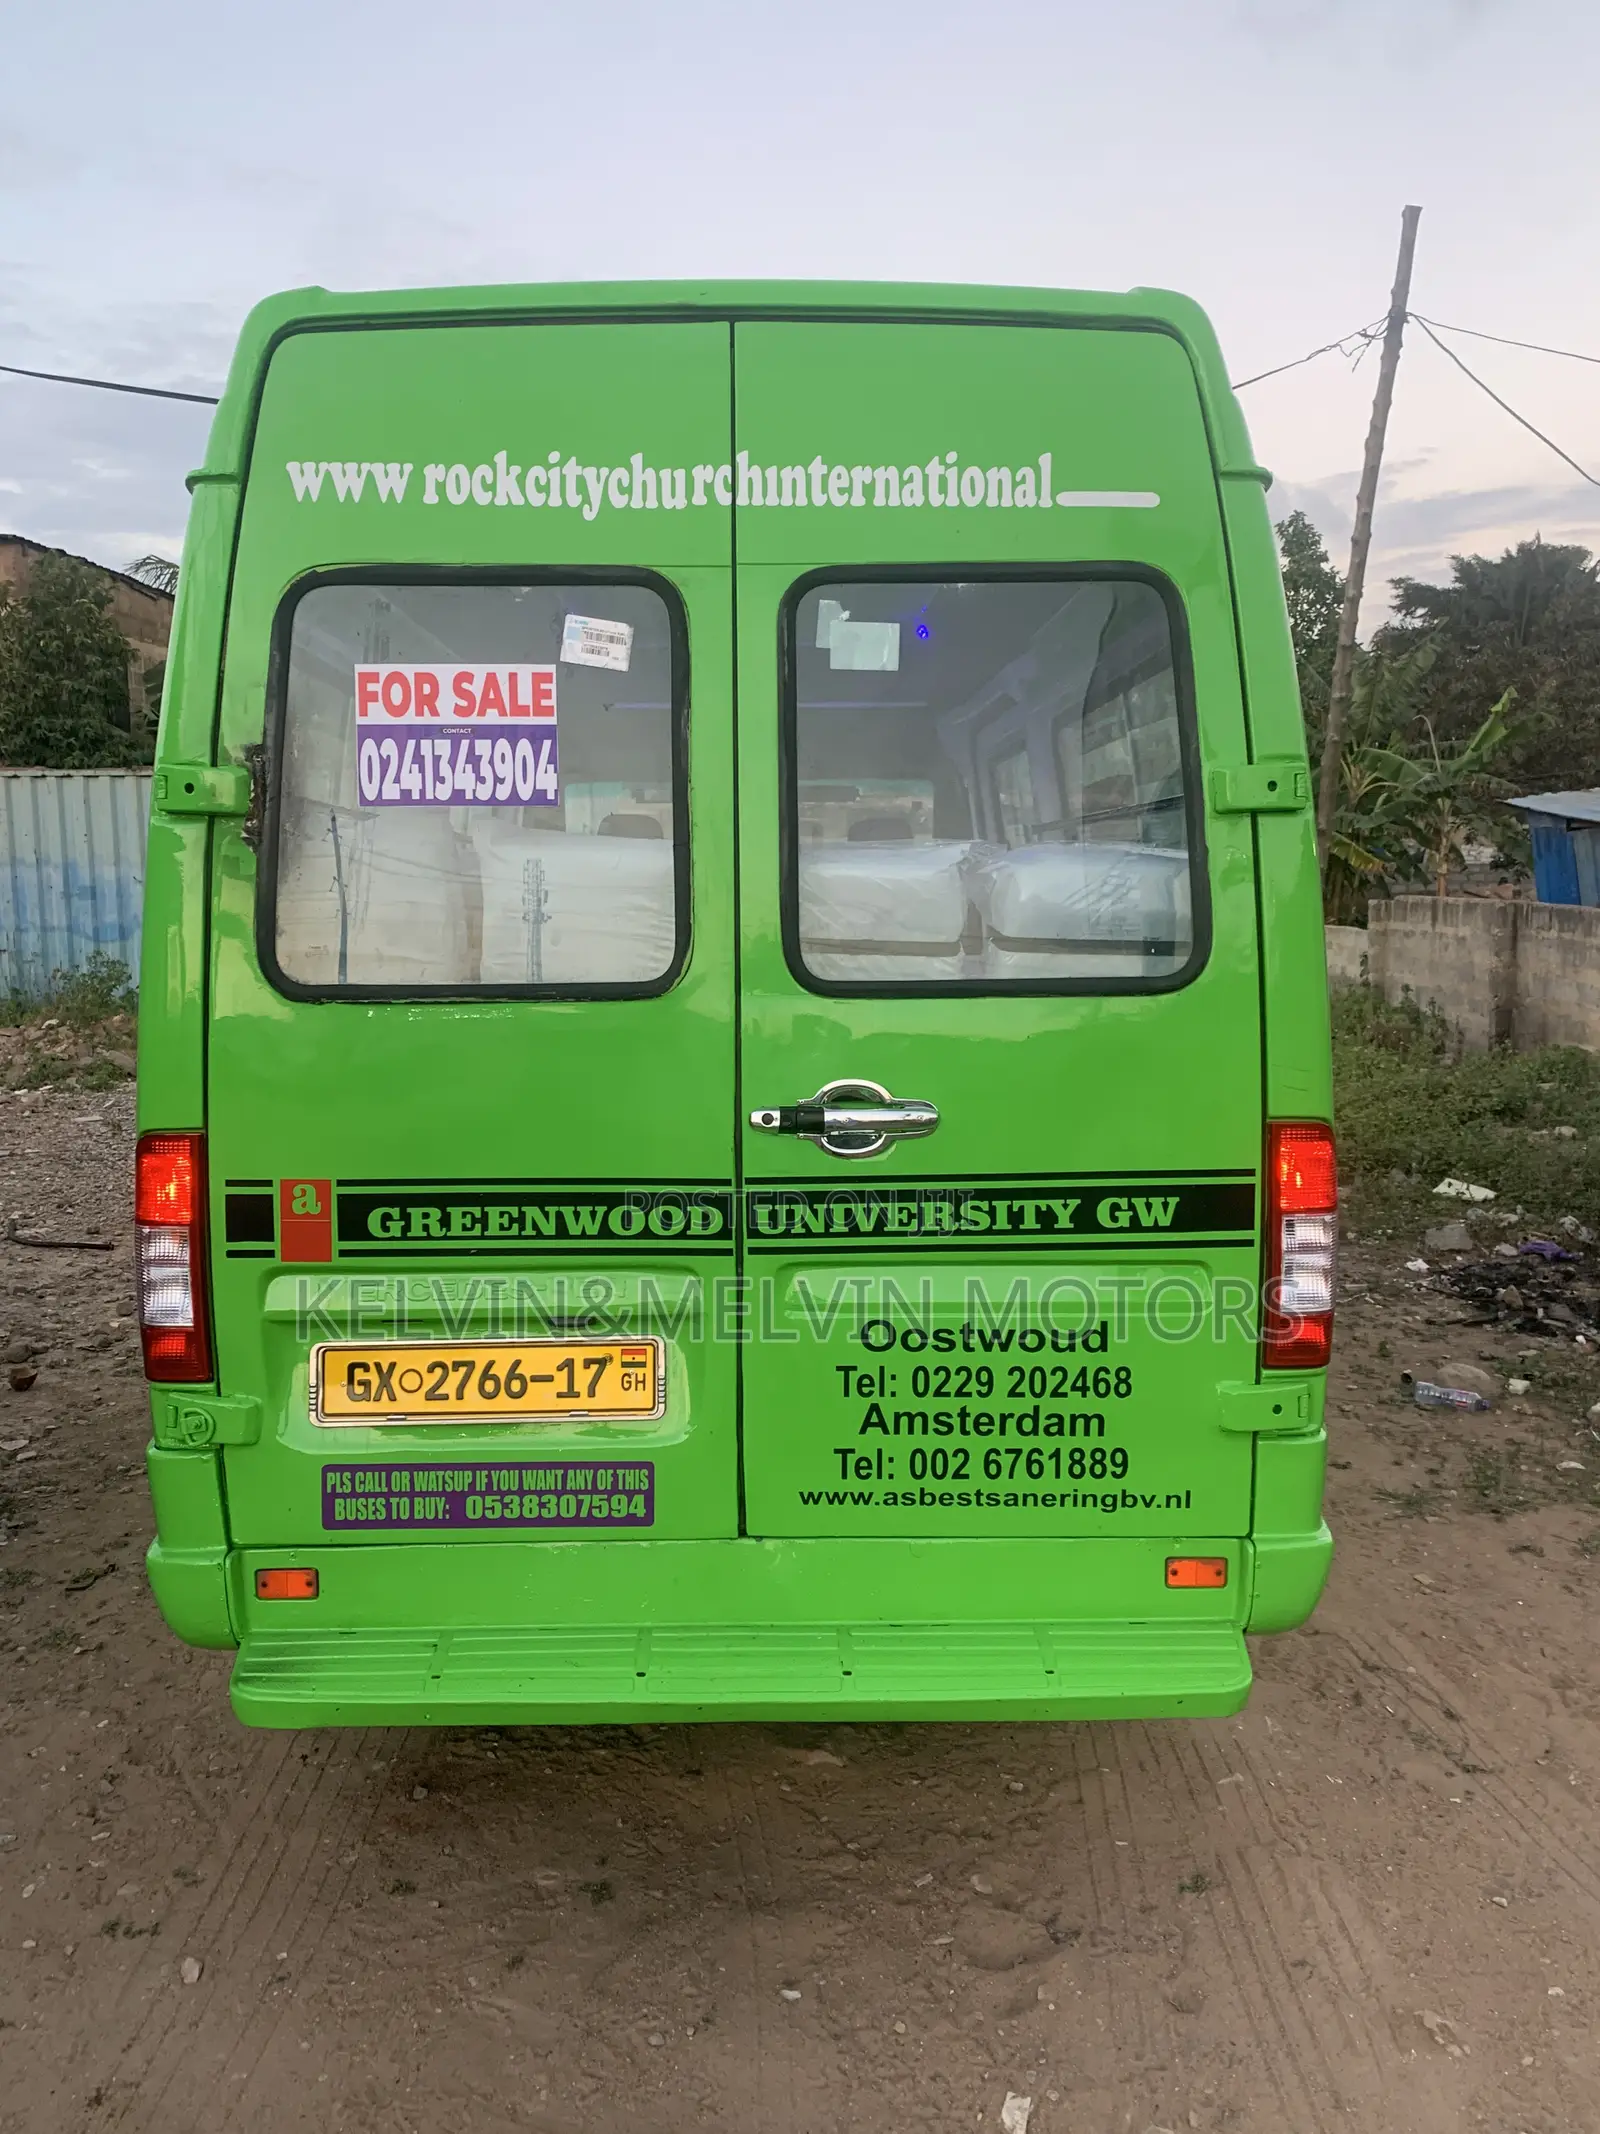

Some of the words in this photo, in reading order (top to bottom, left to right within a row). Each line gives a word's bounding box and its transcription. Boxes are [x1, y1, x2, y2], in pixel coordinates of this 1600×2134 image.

[285, 460, 414, 503] www
[357, 670, 441, 718] FOR
[451, 670, 556, 718] SALE
[442, 727, 472, 735] CONTACT
[359, 738, 558, 802] 0241343904
[291, 1183, 322, 1216] a
[366, 1204, 725, 1239] GREENWOOD
[754, 1197, 1082, 1236] UNIVERSITY
[1095, 1196, 1180, 1229] GW
[859, 1319, 1110, 1354] Oostwoud
[620, 1372, 647, 1393] GH
[835, 1365, 898, 1399] Tel:
[911, 1365, 995, 1399] 0229
[1006, 1365, 1133, 1399] 202468
[858, 1402, 1106, 1438] Amsterdam
[326, 1471, 352, 1494] PLS
[354, 1471, 389, 1493] CALL
[390, 1471, 412, 1493] OR
[413, 1469, 474, 1493] WATSUP
[475, 1470, 489, 1492] IF
[489, 1469, 521, 1492] YOU
[521, 1469, 565, 1492] WANT
[566, 1469, 594, 1491] ANY
[595, 1469, 615, 1491] OF
[615, 1468, 650, 1492] THIS
[833, 1448, 895, 1481] Tel:
[908, 1448, 971, 1481] 002
[982, 1447, 1130, 1481] 6761889
[334, 1497, 387, 1521] BUSES
[389, 1497, 411, 1520] TO
[413, 1496, 451, 1520] BUY:
[464, 1493, 648, 1520] 0538307594
[798, 1486, 1192, 1514] www.asbestsaneringbv.nl
